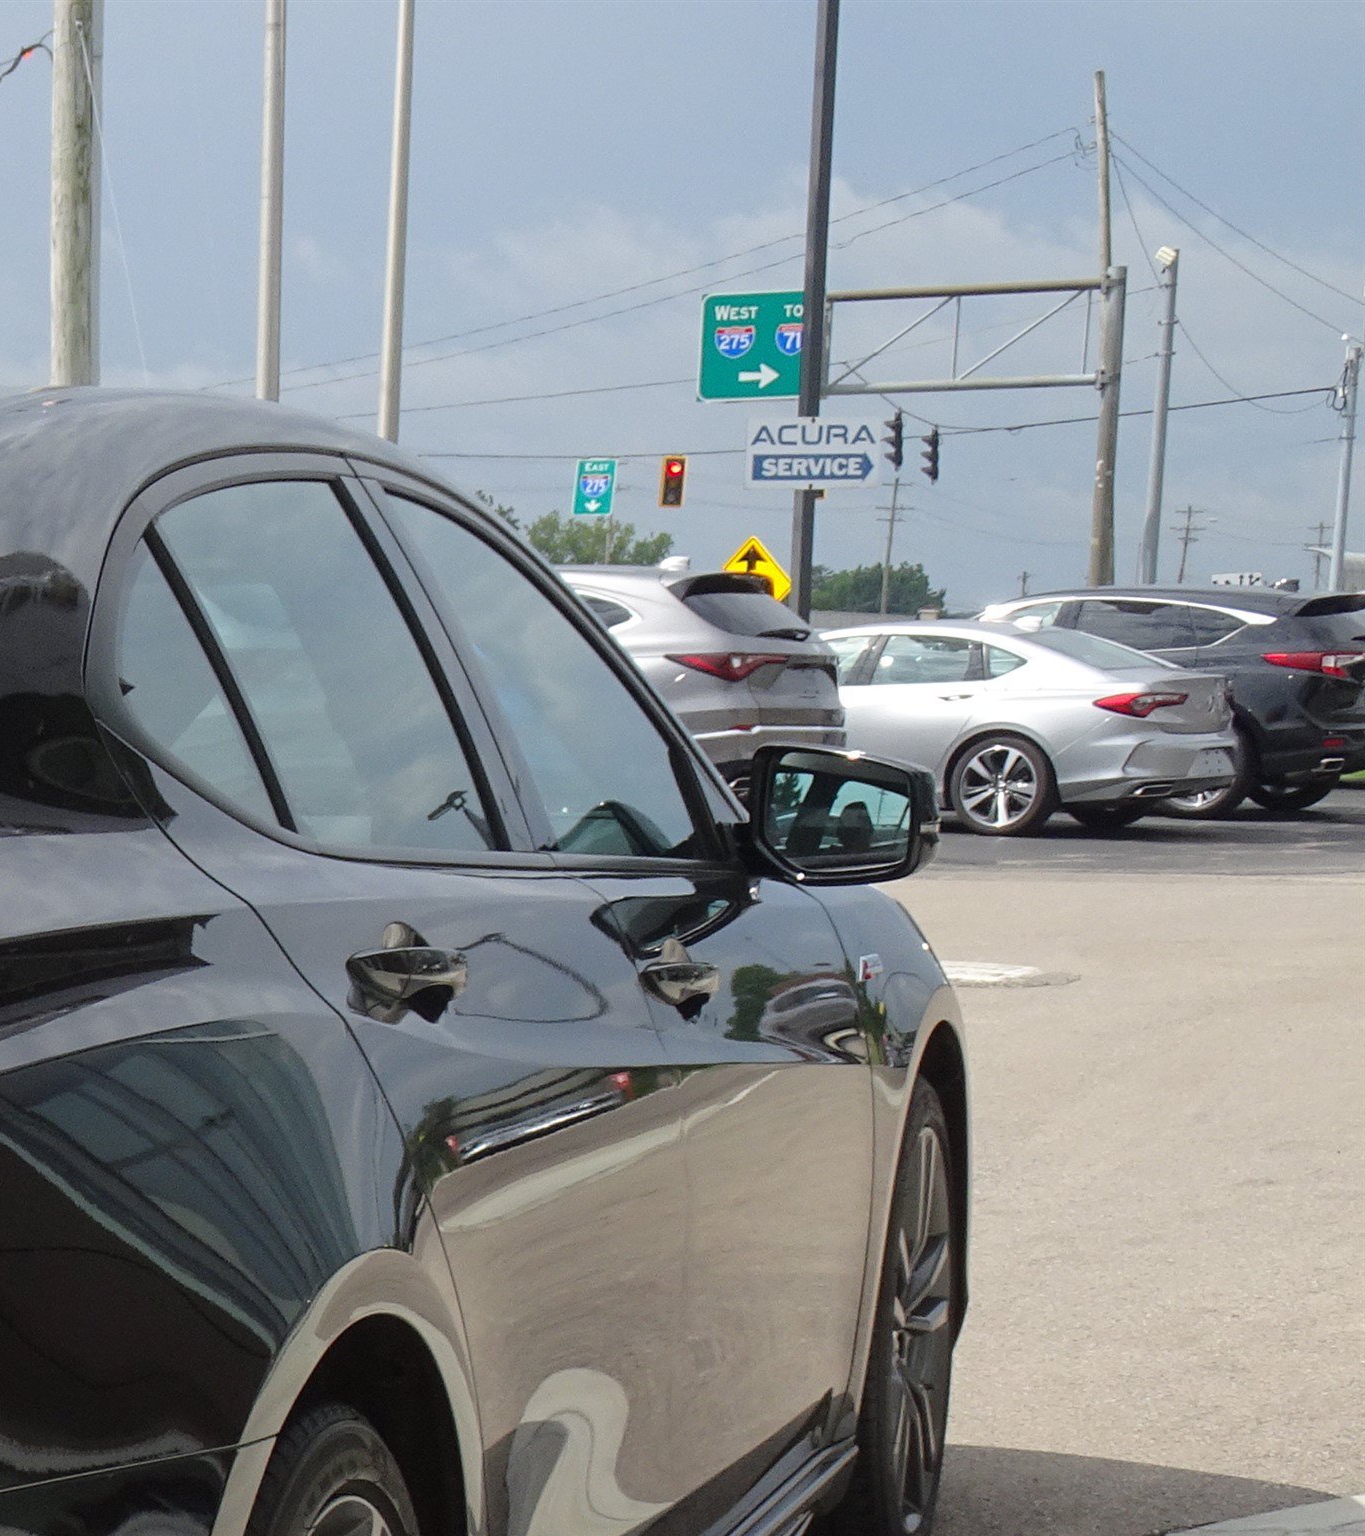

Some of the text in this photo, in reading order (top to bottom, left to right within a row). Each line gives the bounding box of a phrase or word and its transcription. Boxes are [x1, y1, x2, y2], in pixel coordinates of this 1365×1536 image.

[714, 304, 805, 321] WEST TO
[719, 331, 803, 350] 275 71
[751, 424, 876, 446] ACURA
[584, 462, 609, 472] EAST
[761, 457, 864, 477] SERVICE
[585, 479, 607, 493] 275
